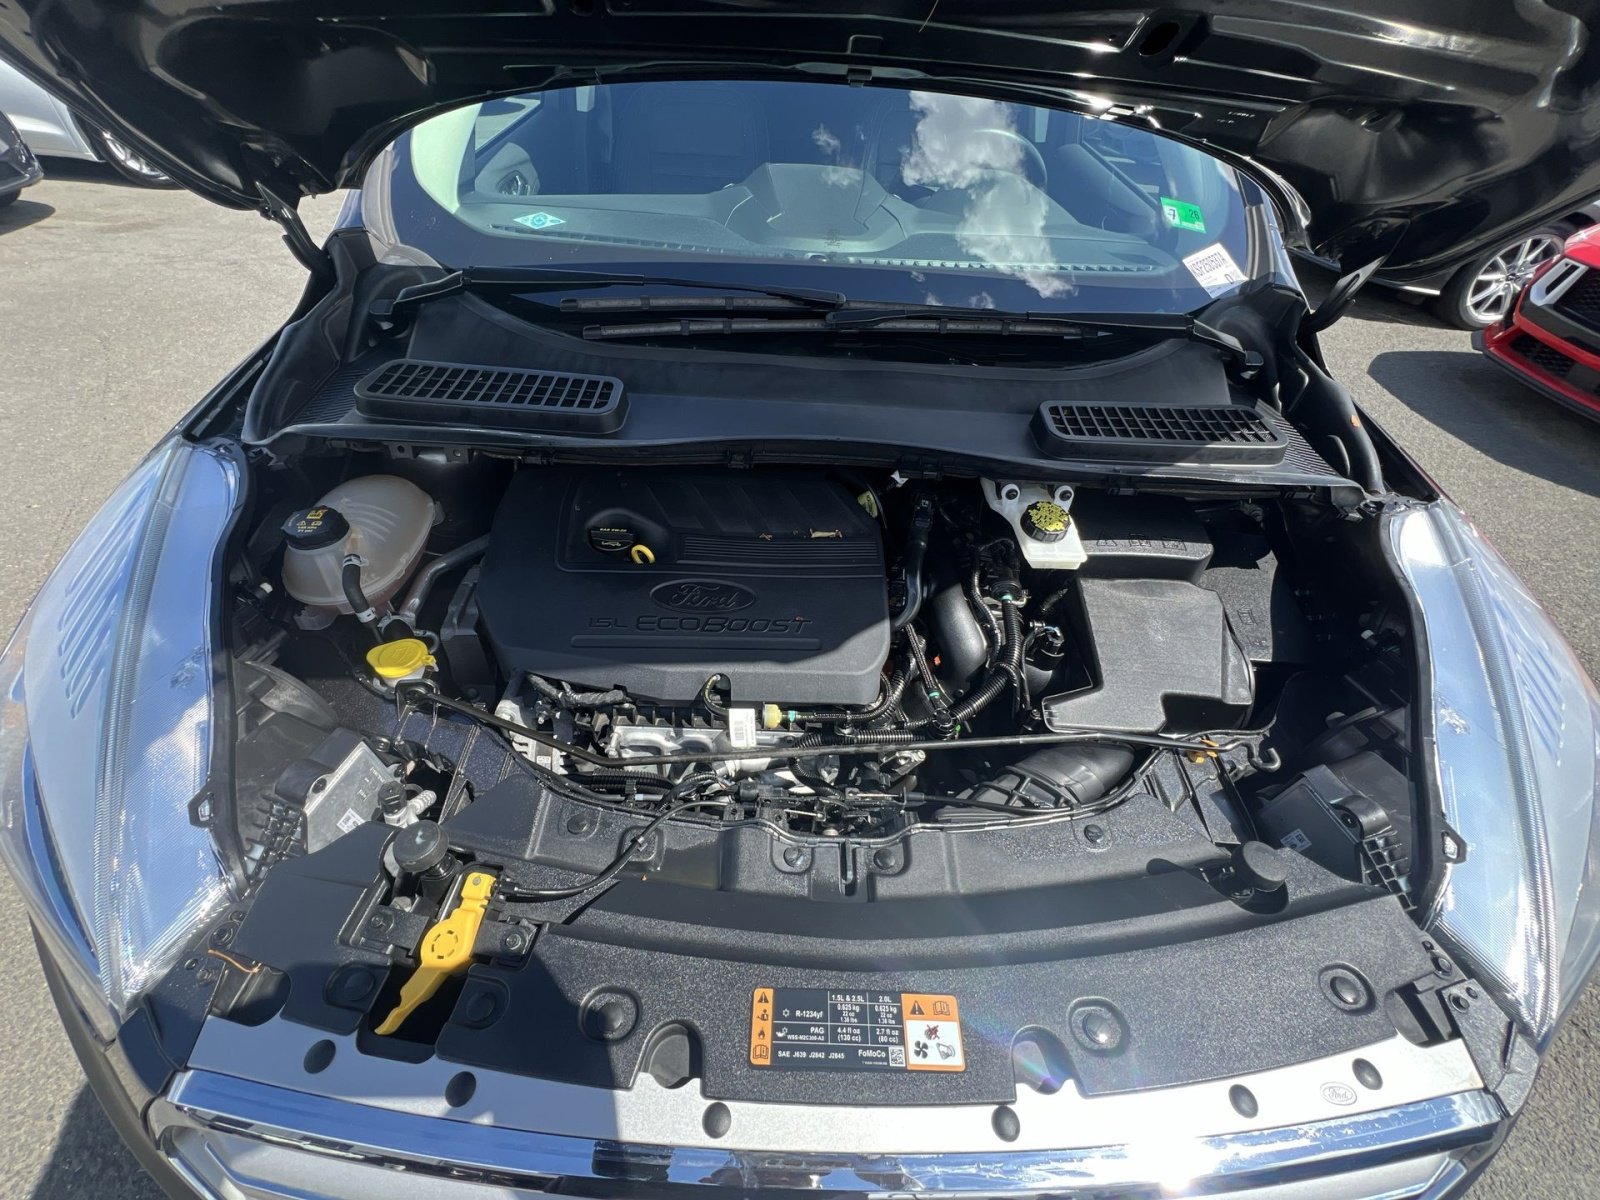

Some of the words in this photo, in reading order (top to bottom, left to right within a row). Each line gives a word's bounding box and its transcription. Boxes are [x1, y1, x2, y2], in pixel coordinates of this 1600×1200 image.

[1189, 209, 1200, 220] 26
[672, 583, 739, 608] Ford
[878, 995, 892, 1003] 2.0L
[795, 1009, 823, 1019] R-1234yf
[837, 1034, 850, 1042] (130
[858, 1049, 886, 1058] FoMoCo
